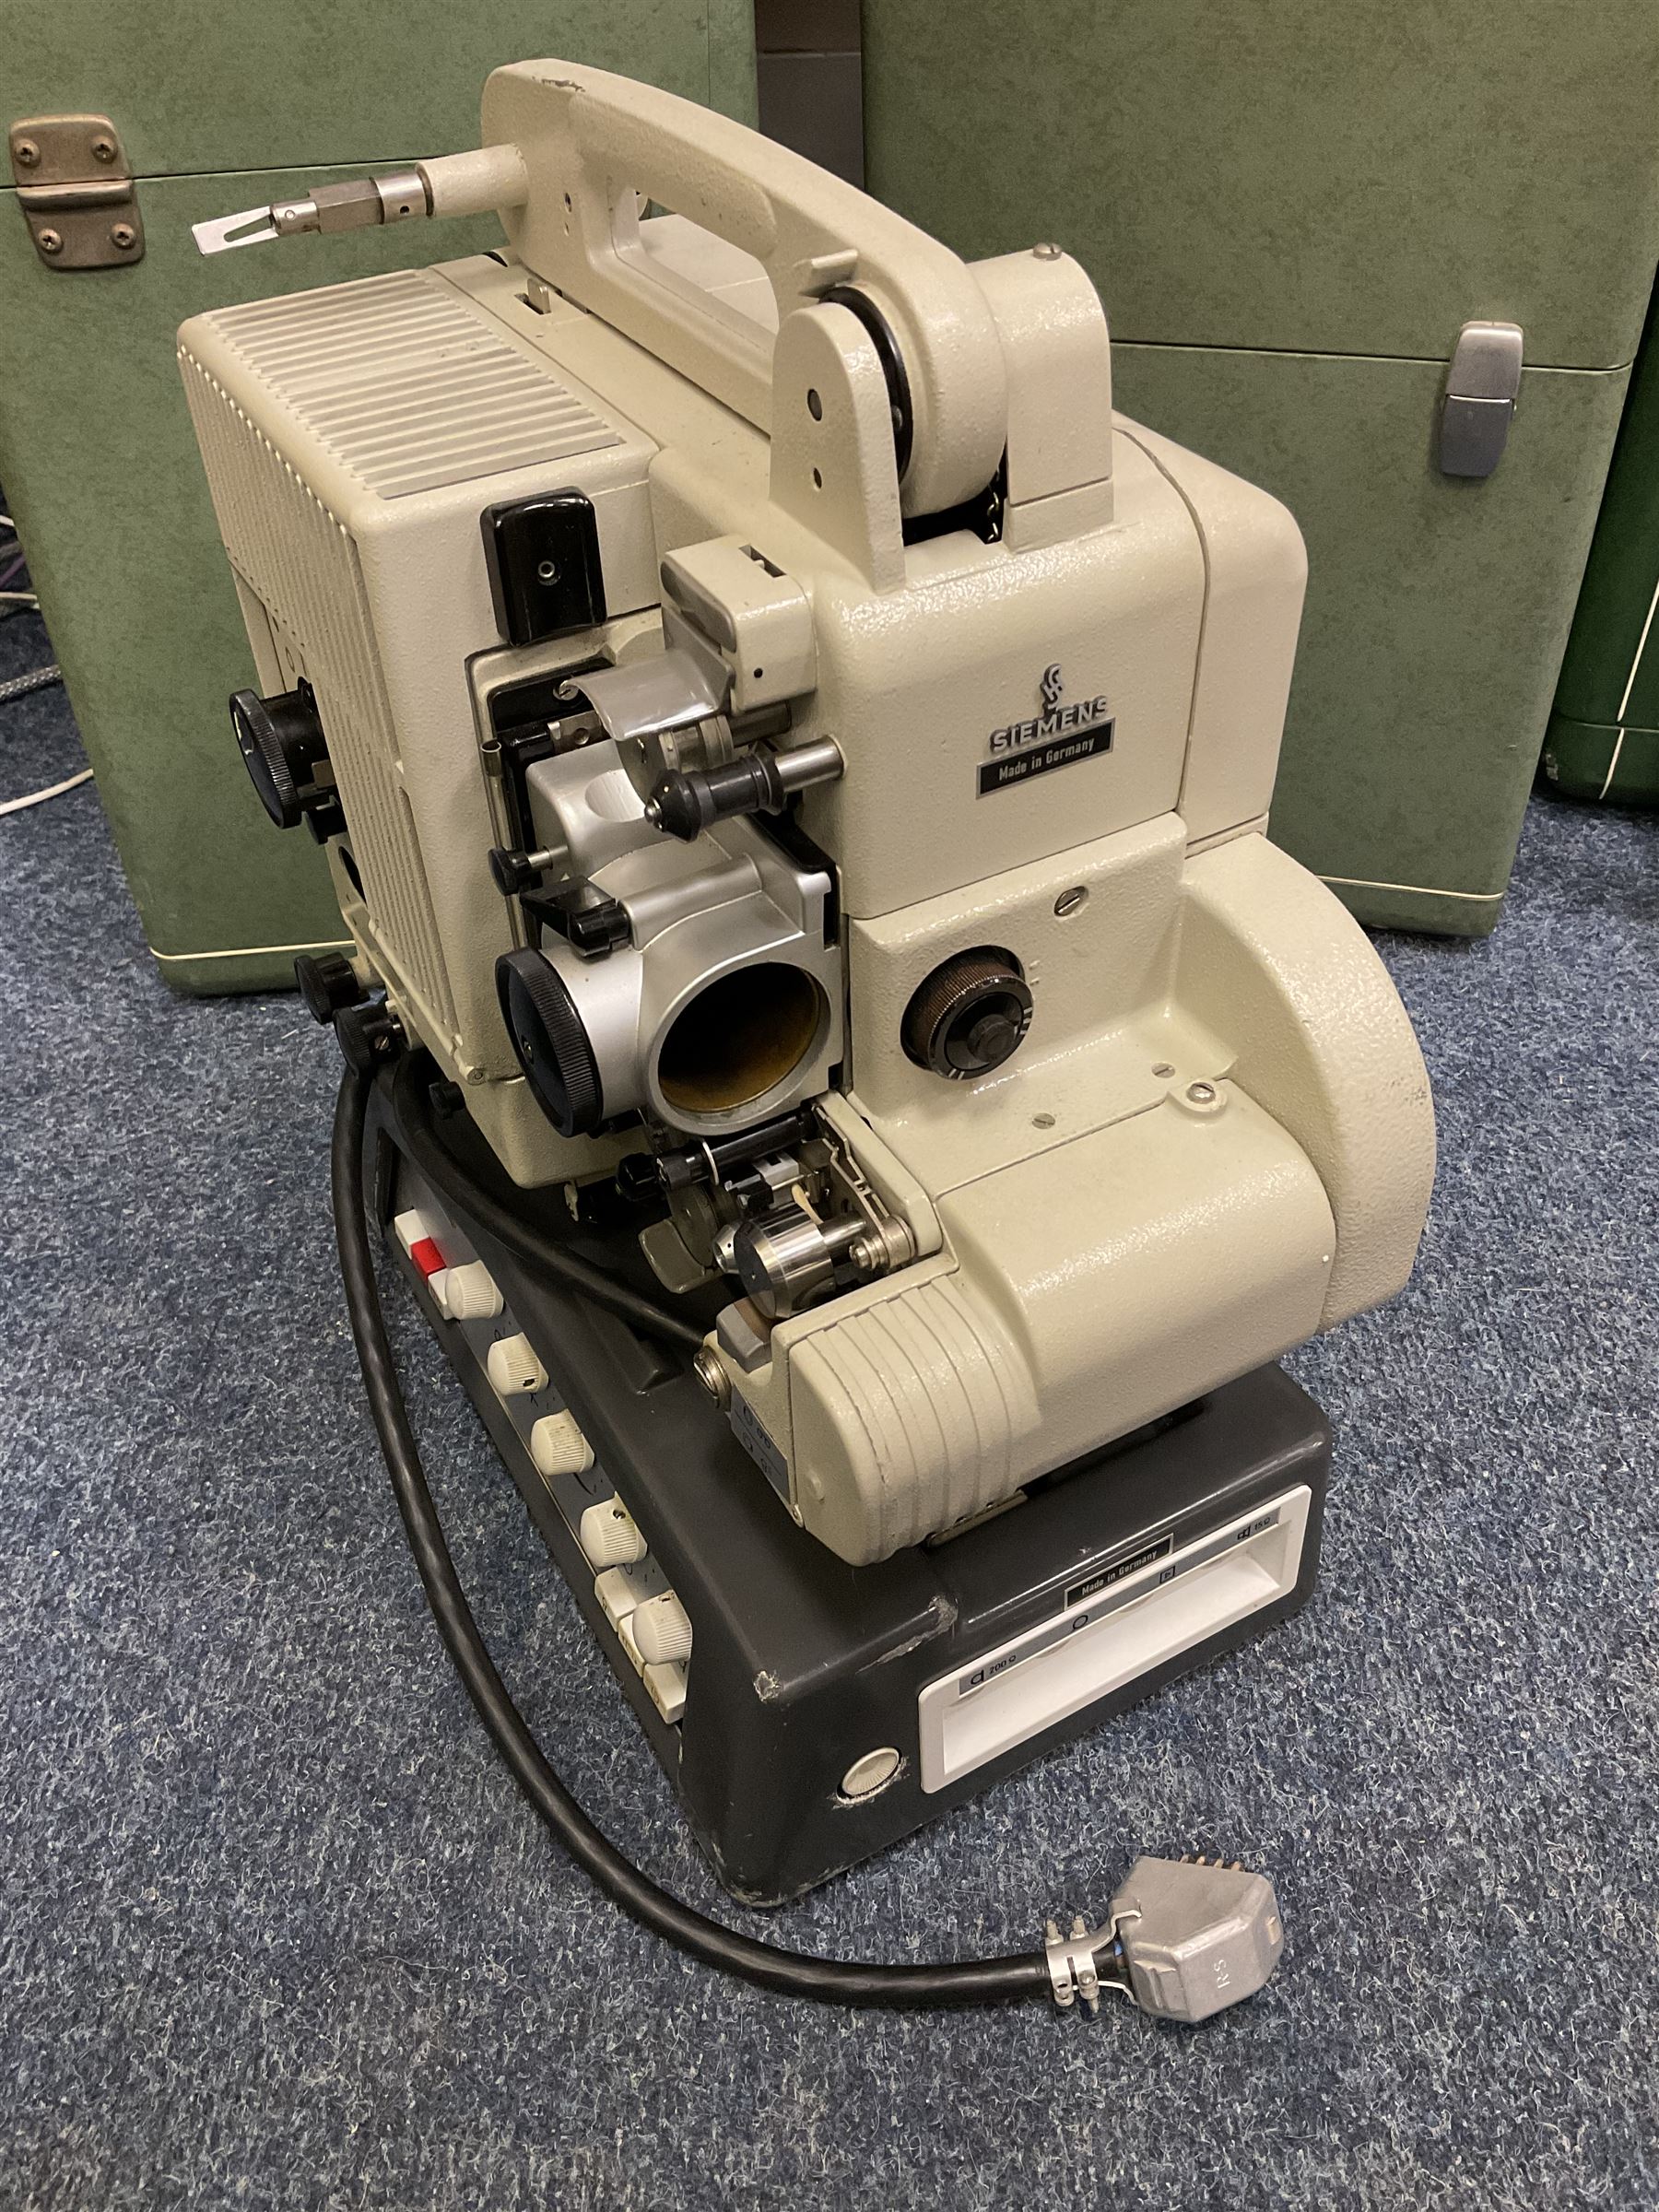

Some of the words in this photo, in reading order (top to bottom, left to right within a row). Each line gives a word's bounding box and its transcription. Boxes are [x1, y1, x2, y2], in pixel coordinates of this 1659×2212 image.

[990, 696, 1107, 754] SIEMENS
[998, 761, 1027, 781] Made
[1031, 756, 1042, 770] in
[1045, 737, 1095, 764] Germany
[1081, 1578, 1104, 1595] Made
[1107, 1571, 1116, 1583] in
[1118, 1550, 1158, 1576] Germany
